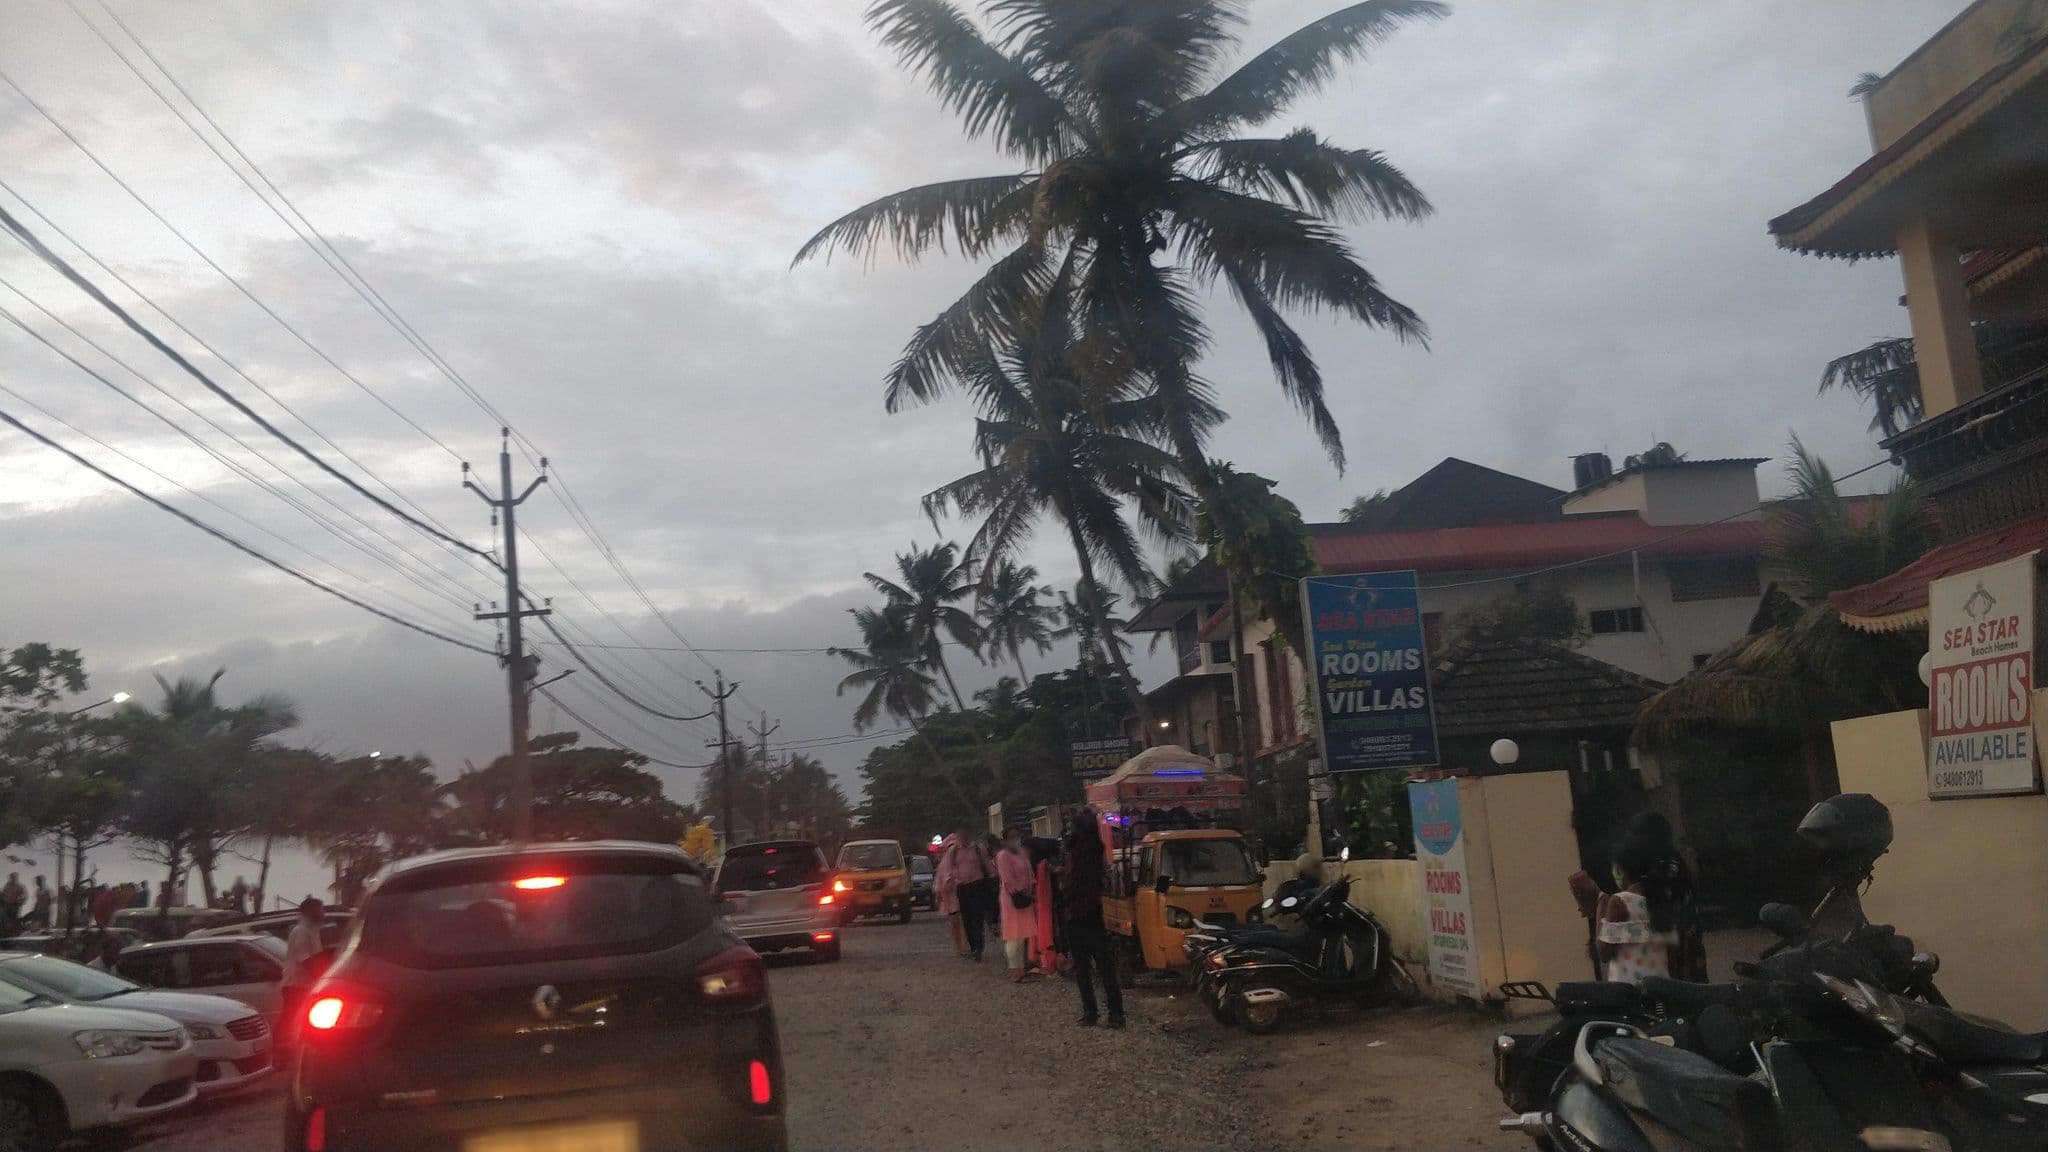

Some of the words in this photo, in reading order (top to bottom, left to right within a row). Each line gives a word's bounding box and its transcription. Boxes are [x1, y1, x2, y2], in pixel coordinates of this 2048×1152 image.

[1943, 628, 1973, 651] SEA
[1977, 616, 2019, 643] STAR
[1322, 648, 1421, 676] ROOMS
[1971, 646, 1993, 657] Beach
[1995, 643, 2019, 654] Homes
[1327, 687, 1425, 714] VILLAS
[1936, 658, 2027, 730] ROOMS
[1935, 733, 2027, 765] AVAILABLE
[1426, 871, 1462, 895] ROOMS
[1430, 909, 1467, 936] VILLAS
